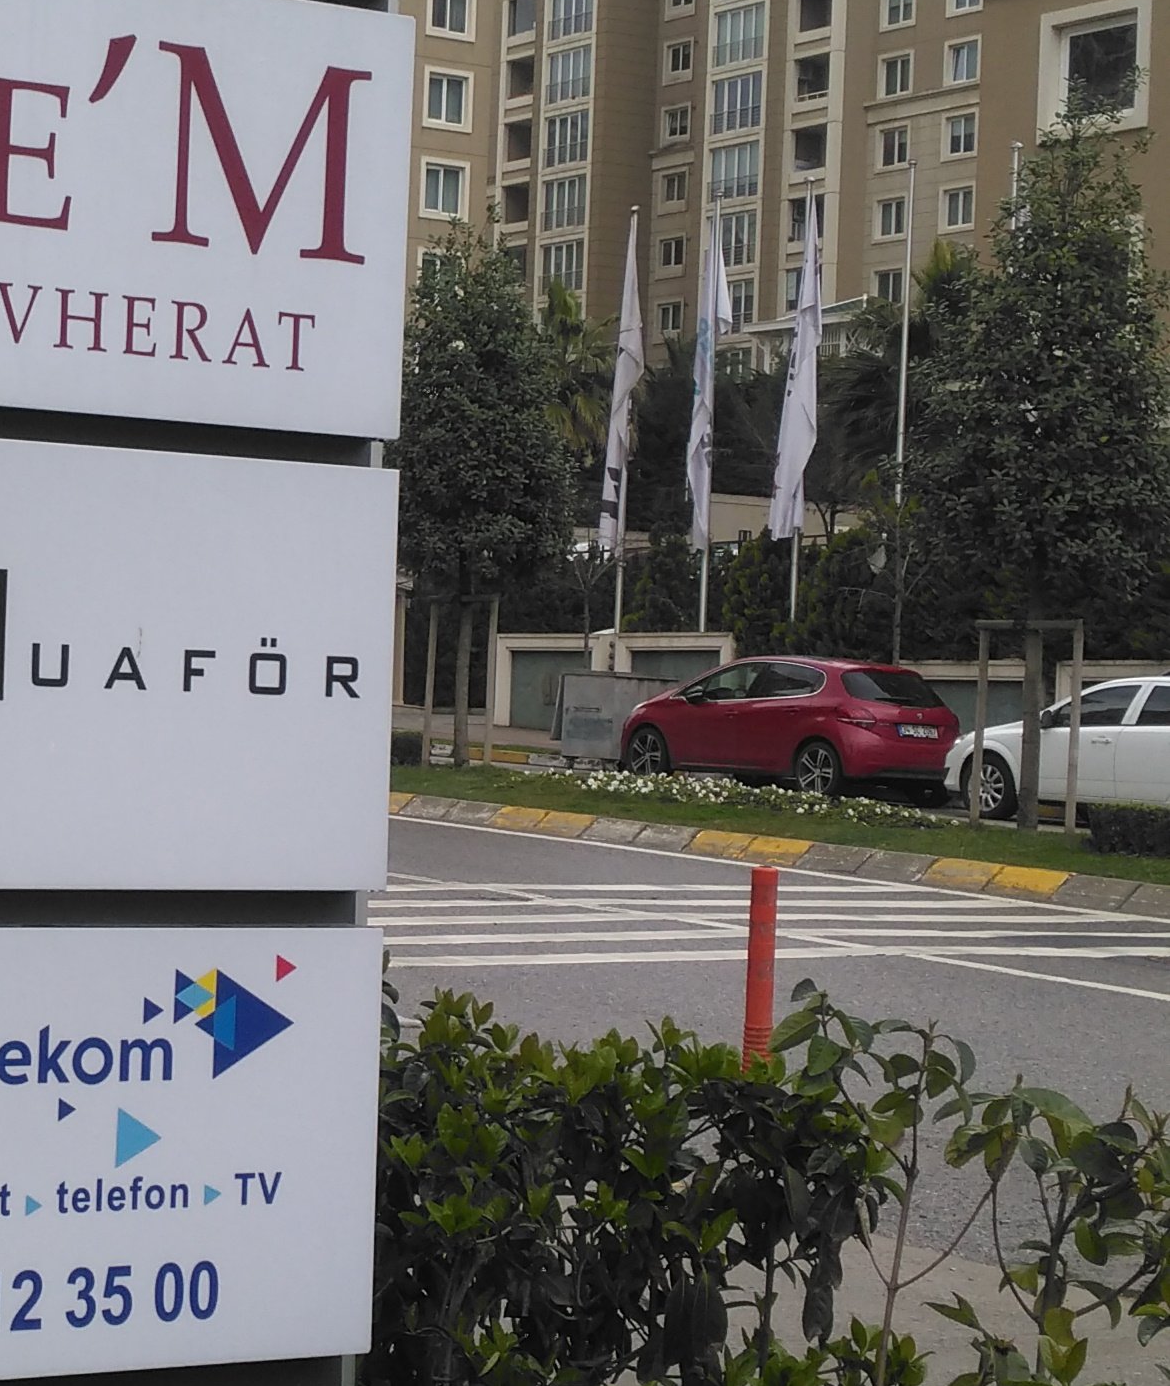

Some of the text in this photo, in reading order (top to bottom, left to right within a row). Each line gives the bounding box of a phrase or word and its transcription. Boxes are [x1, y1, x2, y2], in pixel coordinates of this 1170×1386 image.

[56, 1180, 190, 1213] telefon
[234, 1171, 282, 1205] TV
[64, 1266, 133, 1328] 35
[154, 1260, 219, 1323] 00
